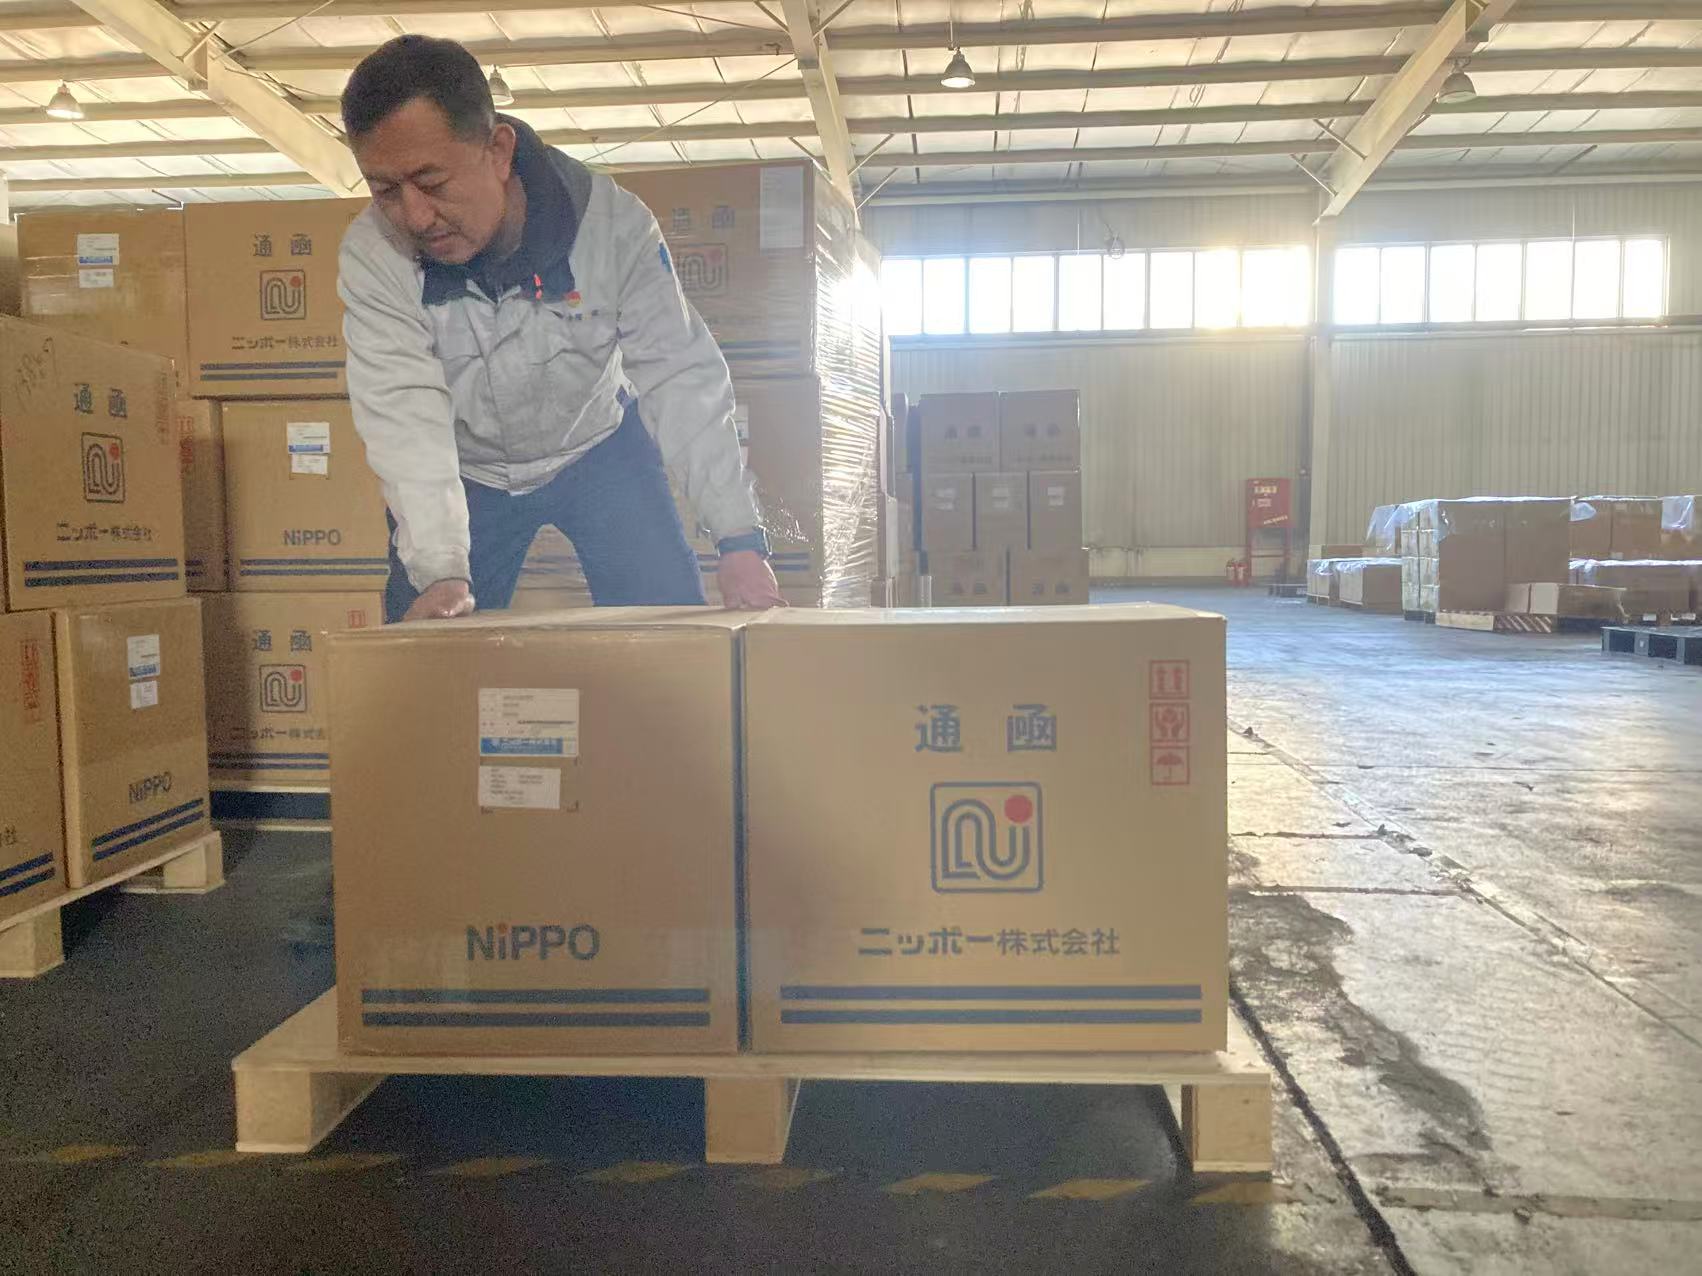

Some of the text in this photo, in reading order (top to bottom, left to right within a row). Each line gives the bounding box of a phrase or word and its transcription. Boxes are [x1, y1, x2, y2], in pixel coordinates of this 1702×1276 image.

[914, 703, 963, 752] 通
[466, 922, 600, 961] NiPPO
[858, 926, 1120, 955] ニッポー株式会社
